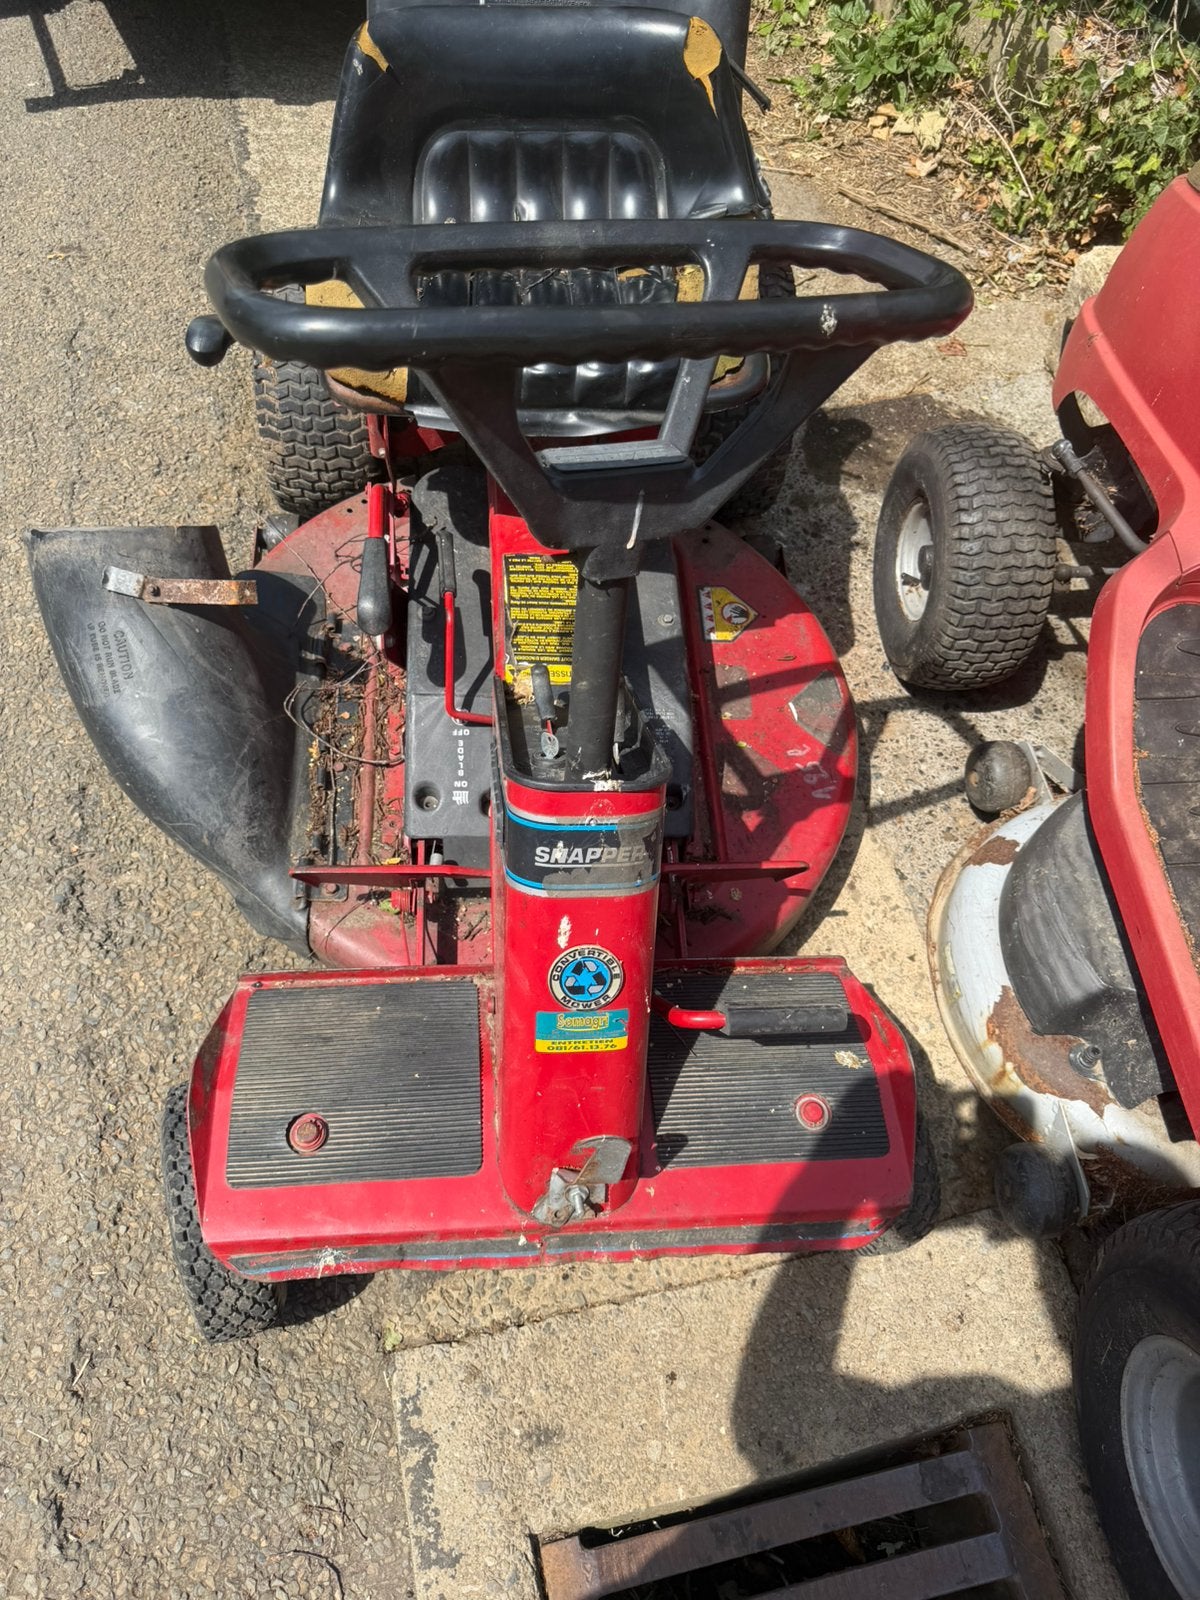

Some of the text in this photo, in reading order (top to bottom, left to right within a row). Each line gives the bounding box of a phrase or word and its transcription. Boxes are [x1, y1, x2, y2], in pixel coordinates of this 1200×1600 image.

[101, 634, 111, 649] NOT
[94, 653, 102, 662] IS
[105, 652, 115, 668] RUN
[113, 630, 134, 680] CAUTION
[110, 670, 122, 694] BLADE
[452, 728, 470, 736] OFF
[457, 740, 465, 776] BLADE
[454, 780, 468, 788] ON
[534, 845, 644, 864] SNAPPER
[552, 948, 620, 982] CONVERTIBLE
[560, 994, 611, 1009] MOWER
[557, 1013, 609, 1029] Somagri
